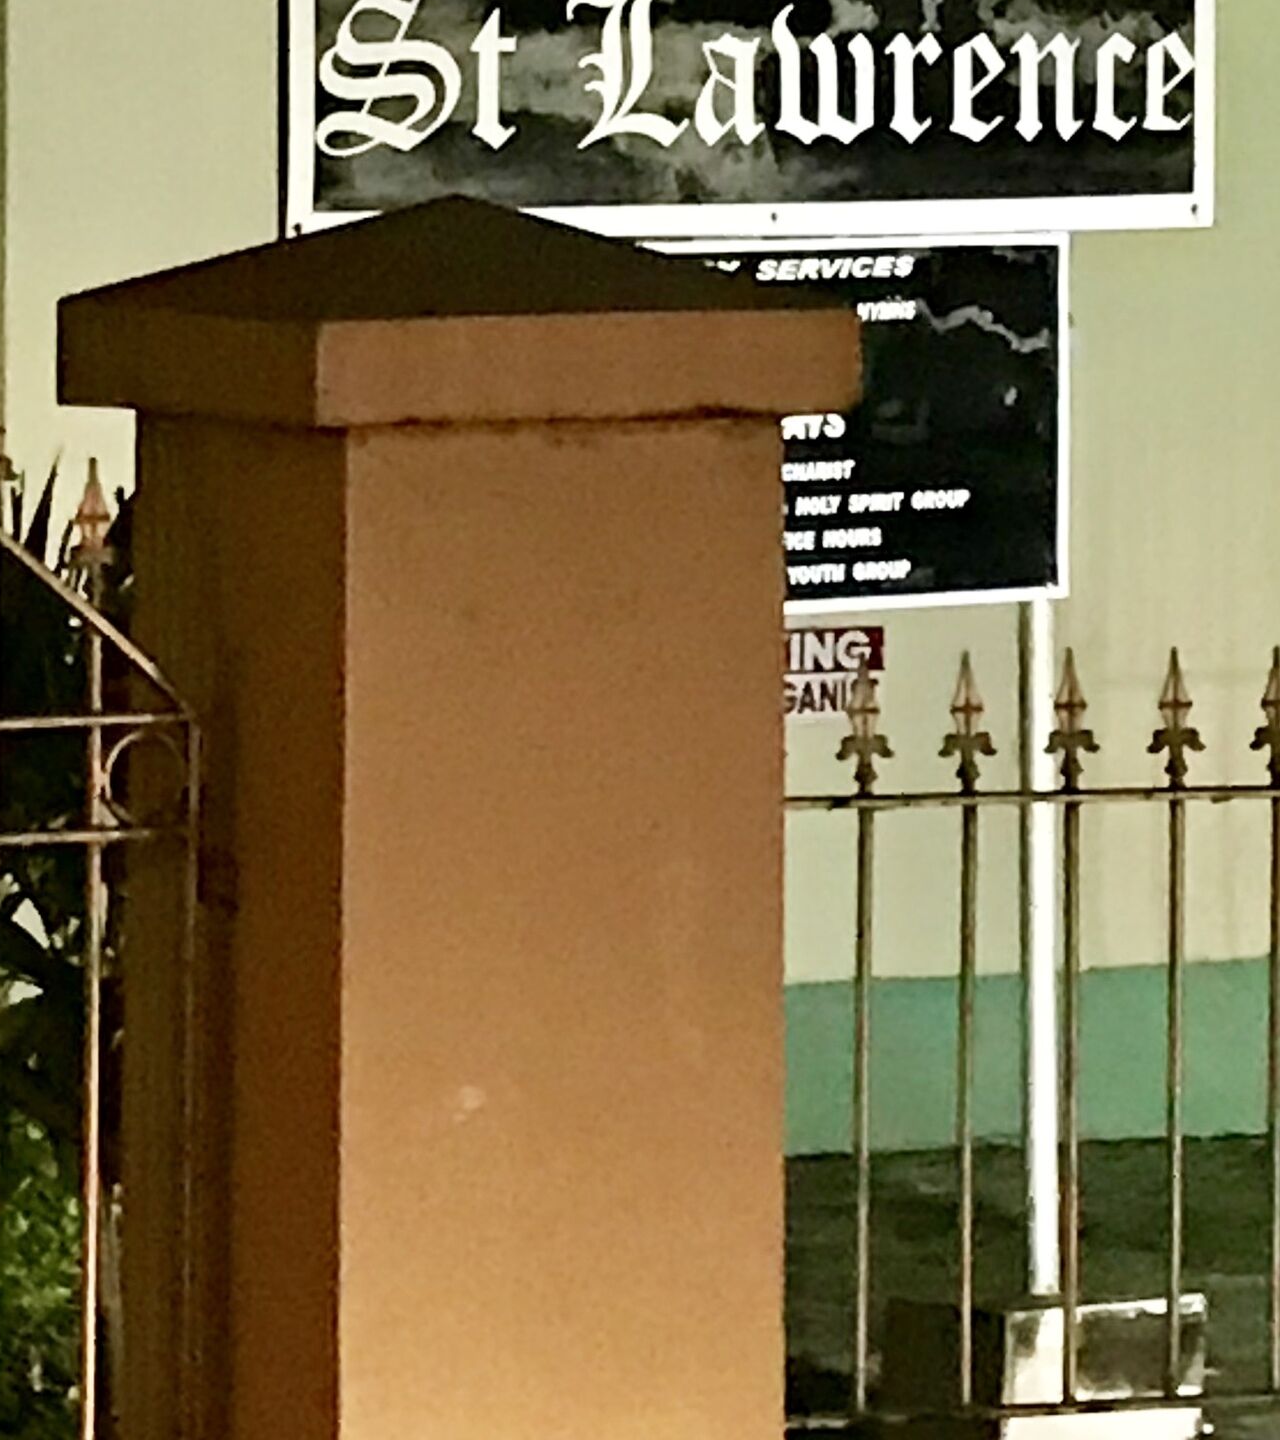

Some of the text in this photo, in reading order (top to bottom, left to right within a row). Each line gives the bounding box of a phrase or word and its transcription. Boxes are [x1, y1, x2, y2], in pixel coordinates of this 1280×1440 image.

[756, 255, 915, 281] SERVICES
[911, 489, 970, 509] GROUP
[852, 560, 911, 581] GROUP
[785, 630, 872, 671] ING
